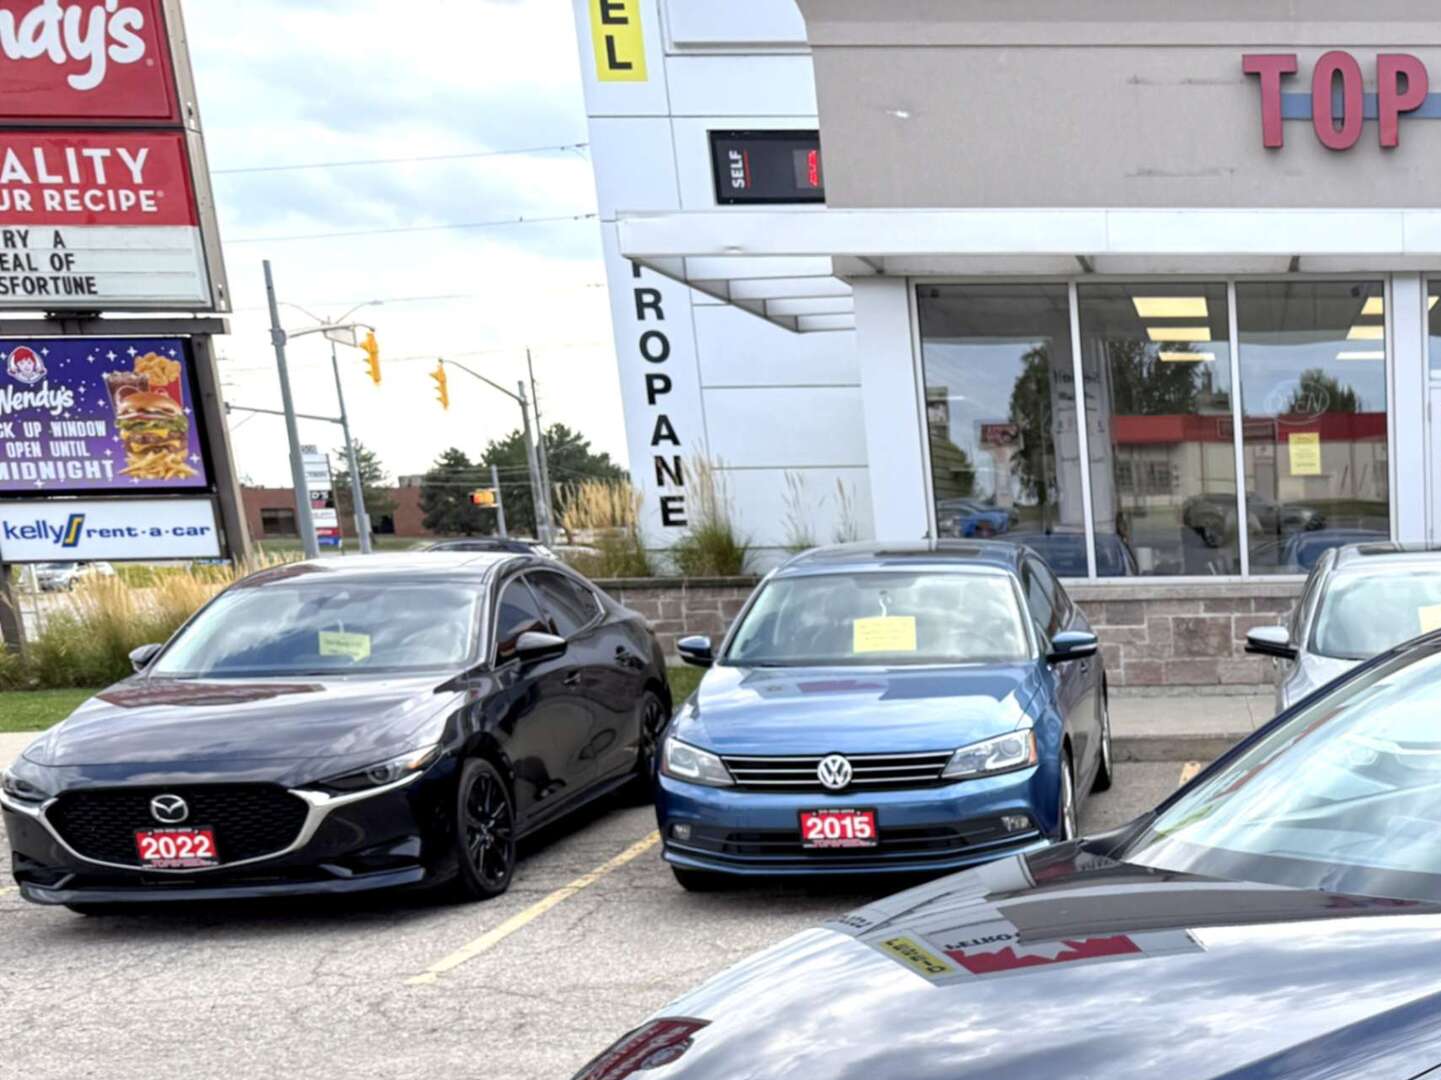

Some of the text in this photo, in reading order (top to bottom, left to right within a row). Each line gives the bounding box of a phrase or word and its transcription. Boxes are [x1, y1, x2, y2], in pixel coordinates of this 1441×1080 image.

[1242, 50, 1429, 150] TOP
[0, 147, 149, 184] ALITY
[729, 150, 745, 188] SELF
[43, 189, 158, 212] RECIPE
[53, 229, 66, 249] A
[50, 252, 75, 272] OF
[23, 421, 42, 438] UP
[50, 421, 107, 437] WINDOW
[6, 440, 91, 458] OPEN UNTIL
[3, 519, 64, 544] kelly
[806, 816, 872, 840] 2015
[141, 835, 212, 860] 2022
